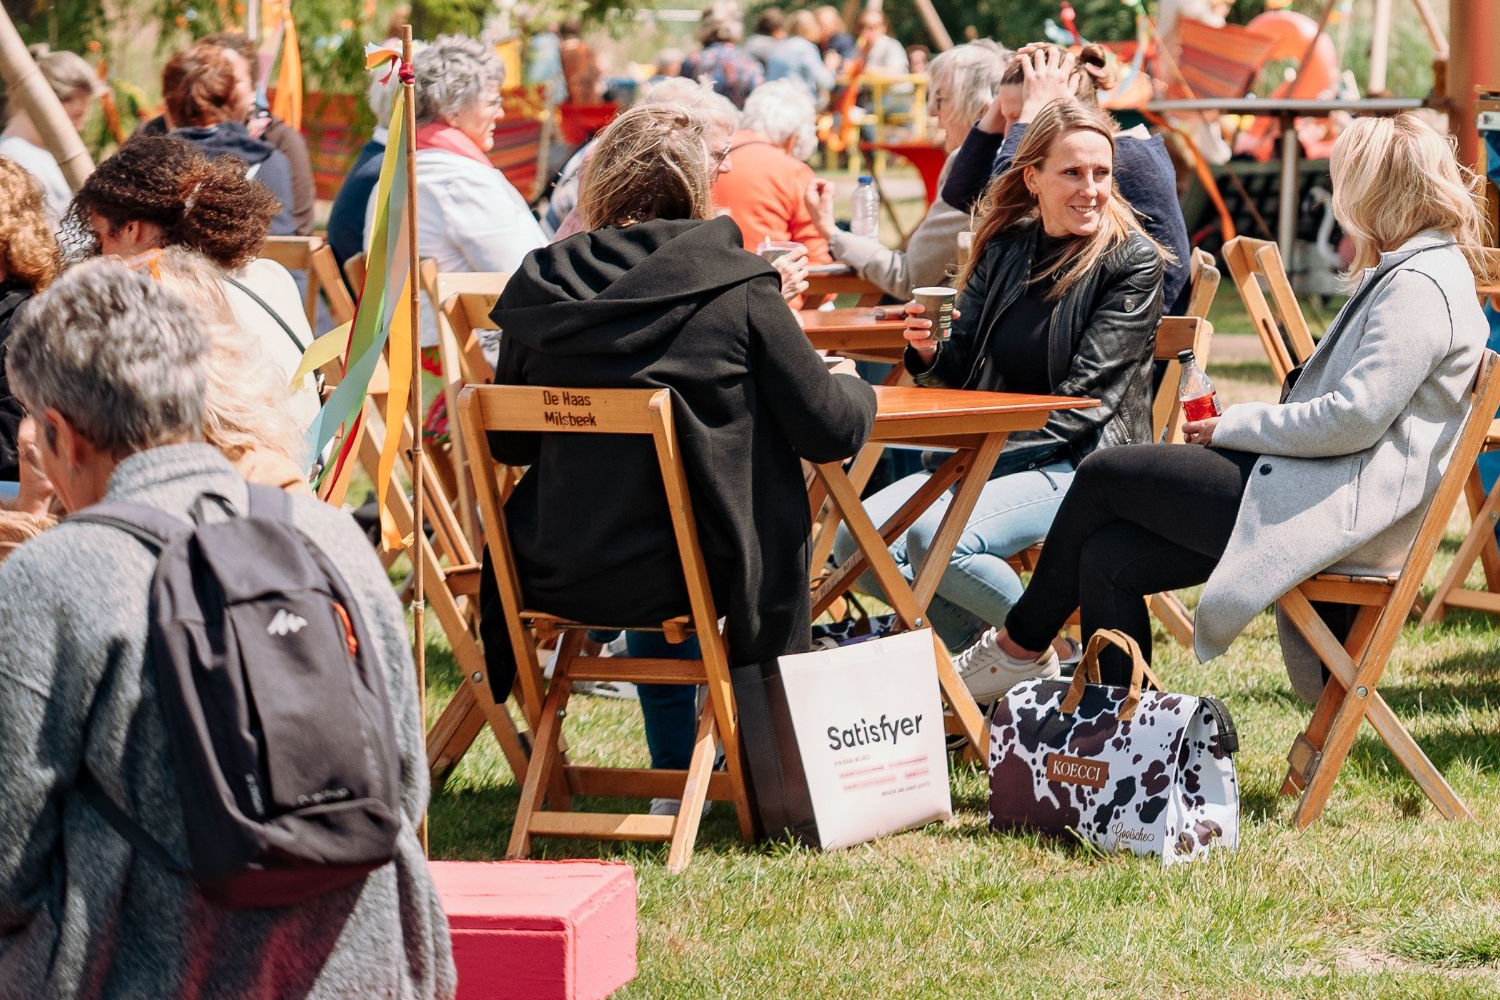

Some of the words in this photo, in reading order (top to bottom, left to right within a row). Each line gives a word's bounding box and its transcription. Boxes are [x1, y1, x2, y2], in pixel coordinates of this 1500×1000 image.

[543, 391, 559, 406] De
[563, 391, 591, 406] Haas
[544, 411, 597, 427] Milsbeek
[827, 713, 923, 751] Satisfyer
[1052, 760, 1101, 781] KOECCI
